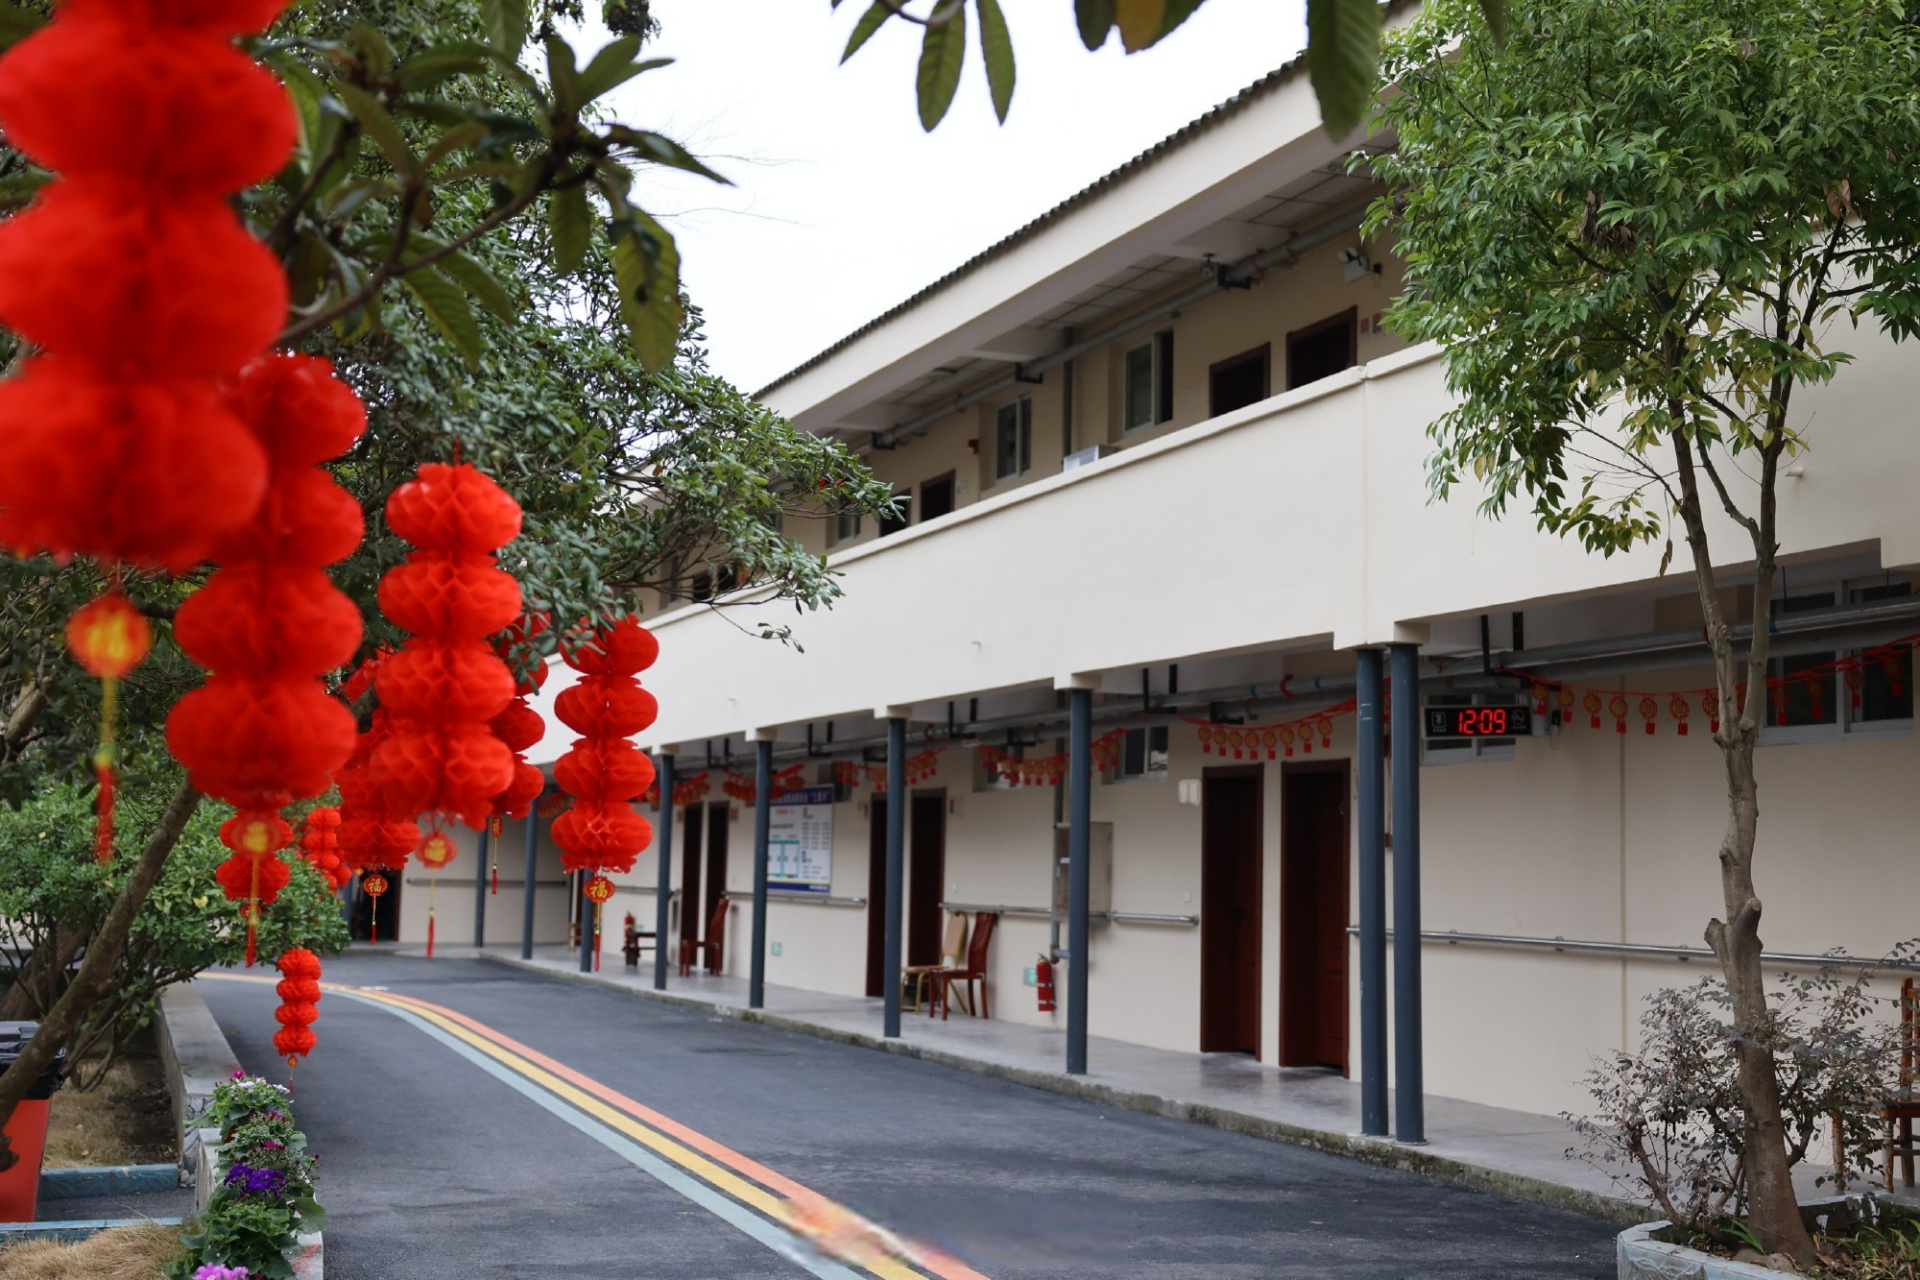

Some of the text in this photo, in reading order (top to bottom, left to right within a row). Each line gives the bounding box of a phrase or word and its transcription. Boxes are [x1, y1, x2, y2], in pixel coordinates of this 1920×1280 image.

[1458, 709, 1506, 734] 12:09
[368, 878, 382, 892] 福
[589, 880, 608, 898] 福
